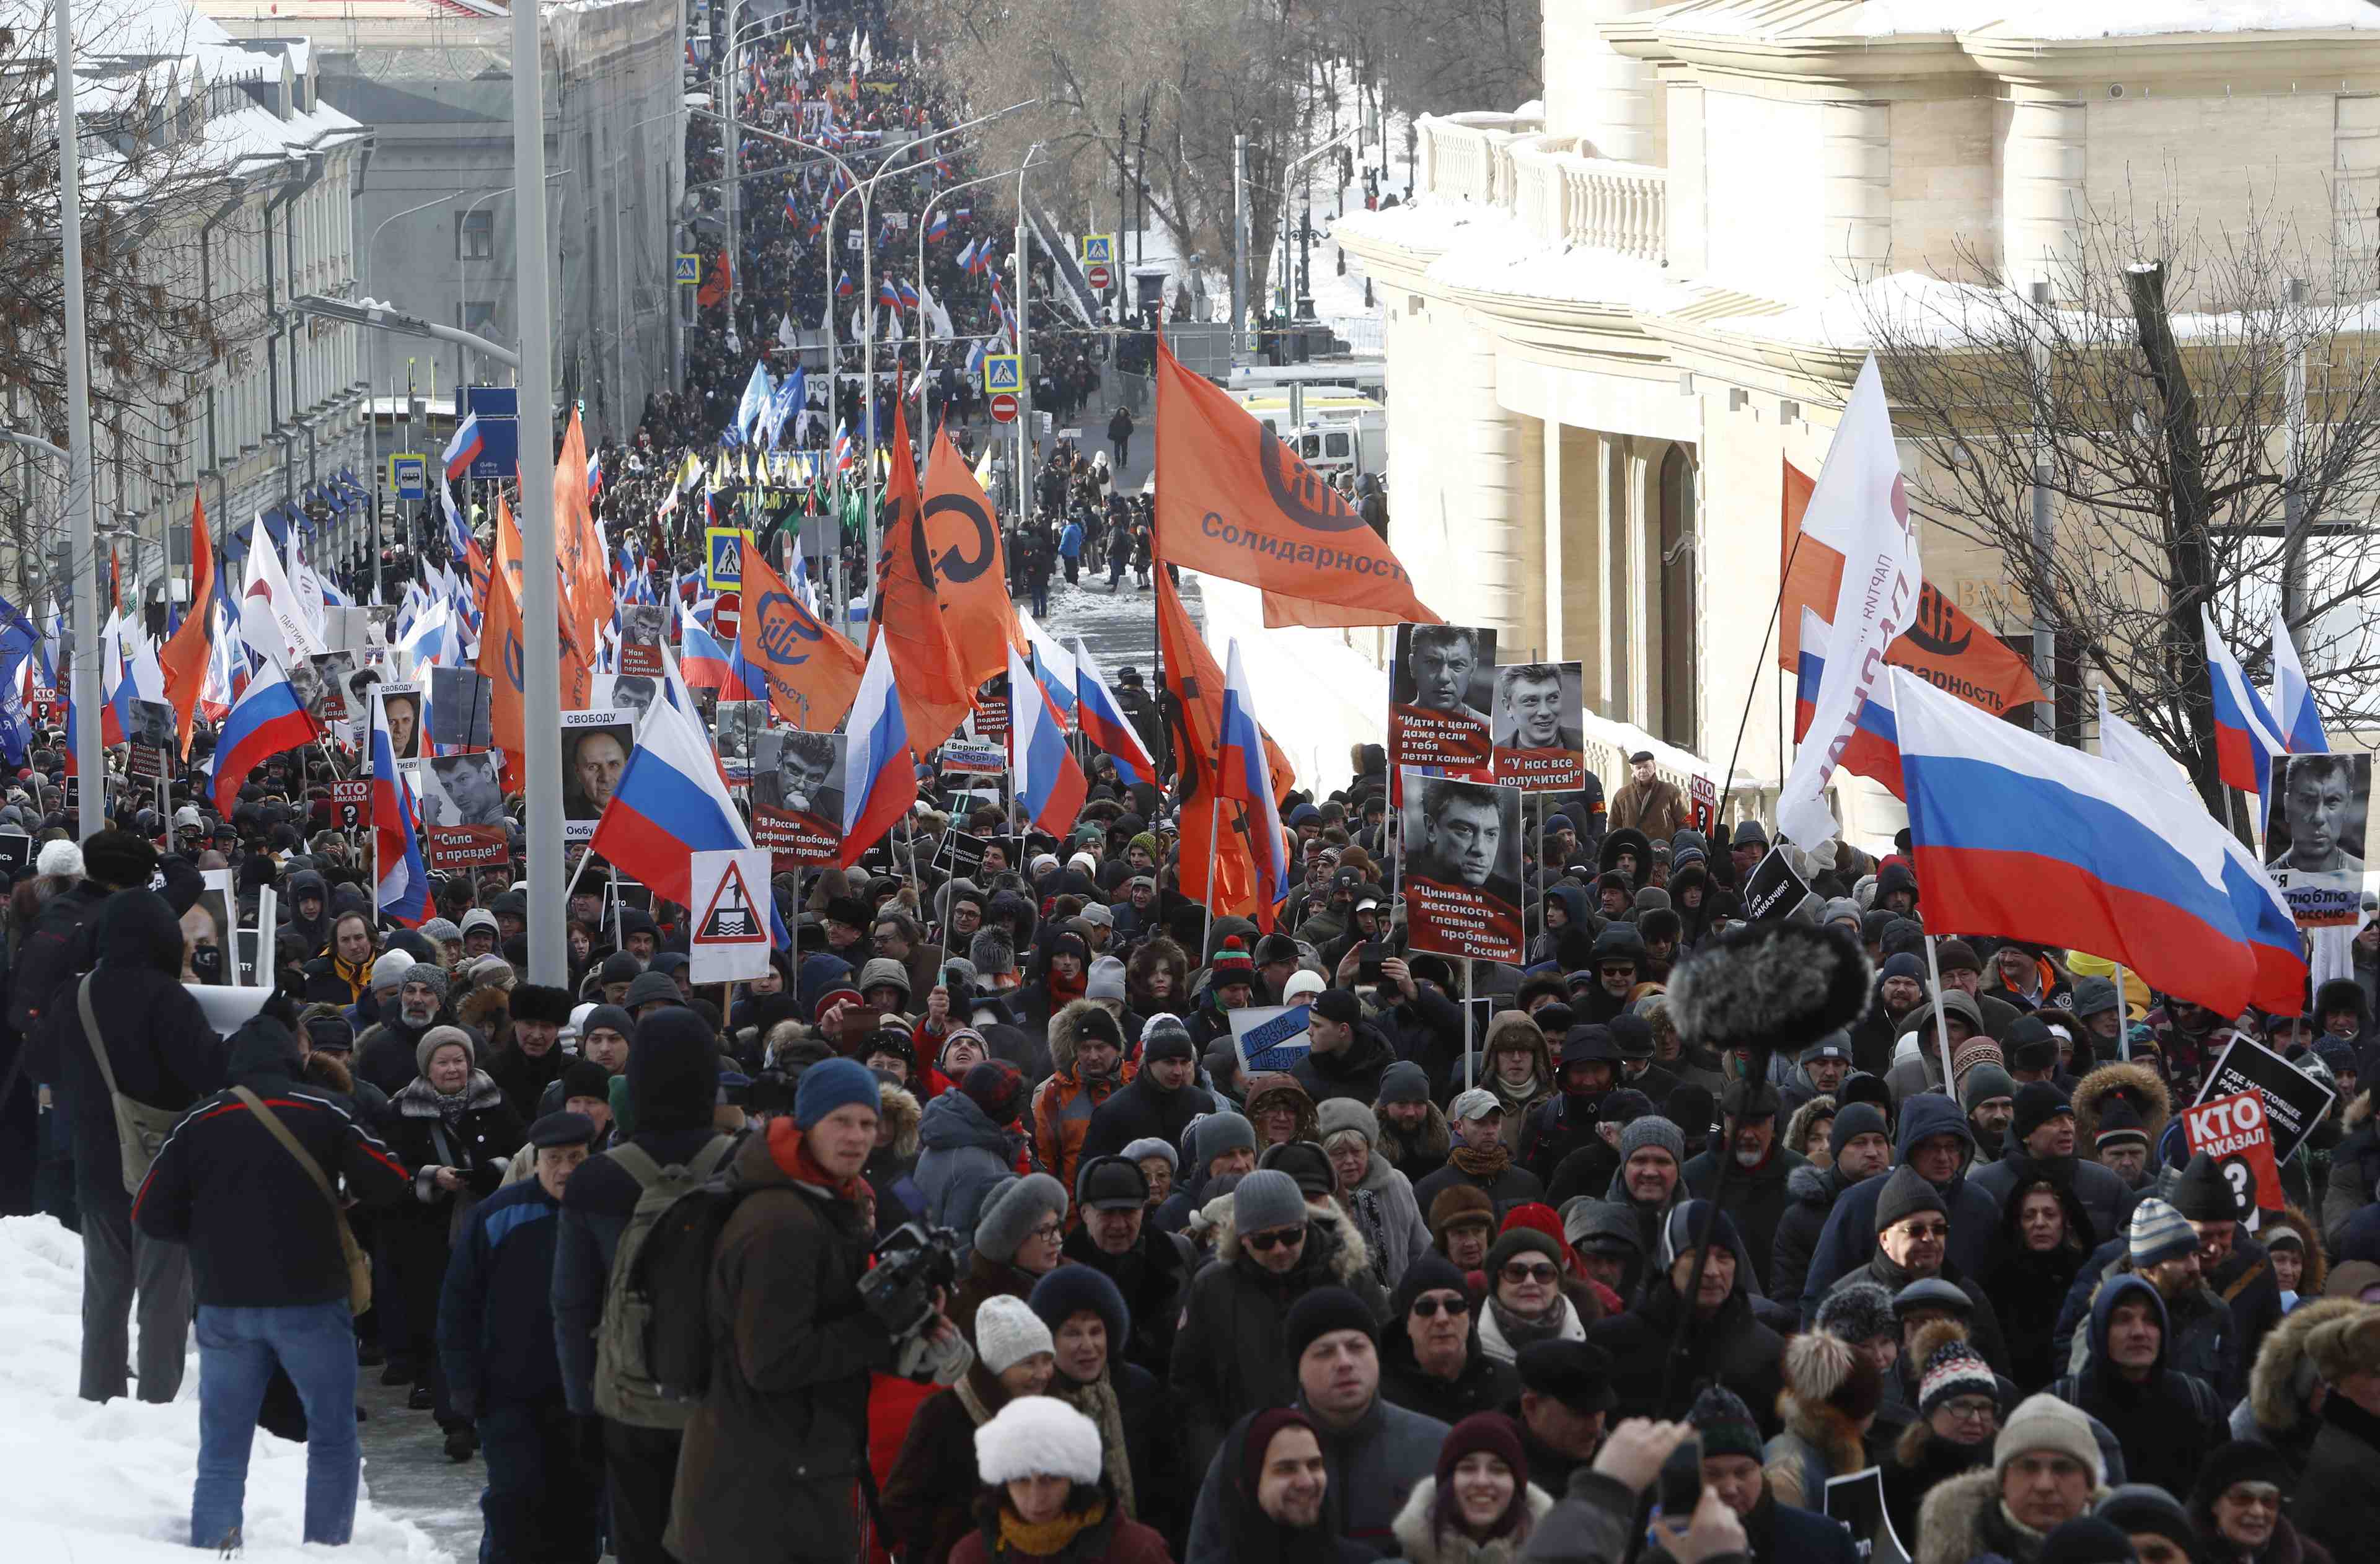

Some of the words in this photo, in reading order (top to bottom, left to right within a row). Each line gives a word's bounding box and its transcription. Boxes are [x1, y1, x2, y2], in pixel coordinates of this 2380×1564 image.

[33, 688, 55, 698] КТО
[381, 683, 413, 693] СВОБОДУ
[567, 713, 617, 724] СВОБОДУ
[1398, 715, 1434, 728] “Идти
[1448, 721, 1481, 732] цели,
[1402, 729, 1435, 739] даже
[1439, 731, 1467, 740] если
[1412, 740, 1439, 750] тебя
[1401, 752, 1434, 762] летят
[1436, 755, 1483, 764] камни”
[1504, 758, 1521, 770] “У
[1524, 758, 1548, 769] нас
[1551, 758, 1574, 768] все
[1499, 770, 1581, 788] получится!”
[1692, 776, 1714, 798] КТО
[333, 782, 368, 796] КТО
[333, 795, 368, 803] ЗАКАЗАЛ
[757, 817, 768, 826] “В
[770, 818, 801, 829] России
[434, 833, 473, 846] “Сила
[756, 830, 795, 842] дефицит
[796, 834, 839, 846] свободы,
[436, 851, 444, 861] в
[446, 843, 503, 863] правде!”
[796, 848, 836, 858] правды”
[1413, 884, 1472, 901] “Цинизм
[1474, 895, 1484, 903] и
[1754, 879, 1790, 920] ЗАКАЗЧИК?
[2287, 889, 2348, 903] люблю
[1420, 901, 1494, 918] жестокость
[1751, 894, 1762, 910] КТО
[1430, 915, 1486, 929] главные
[1440, 929, 1510, 946] проблемы
[1463, 942, 1517, 959] России”
[1247, 1016, 1288, 1042] ПРОТИВ
[1251, 1021, 1300, 1052] ЦЕНЗУРЫ
[2224, 1067, 2246, 1084] ГДЕ
[2188, 1096, 2262, 1144] КТО
[2224, 1162, 2248, 1207] ?
